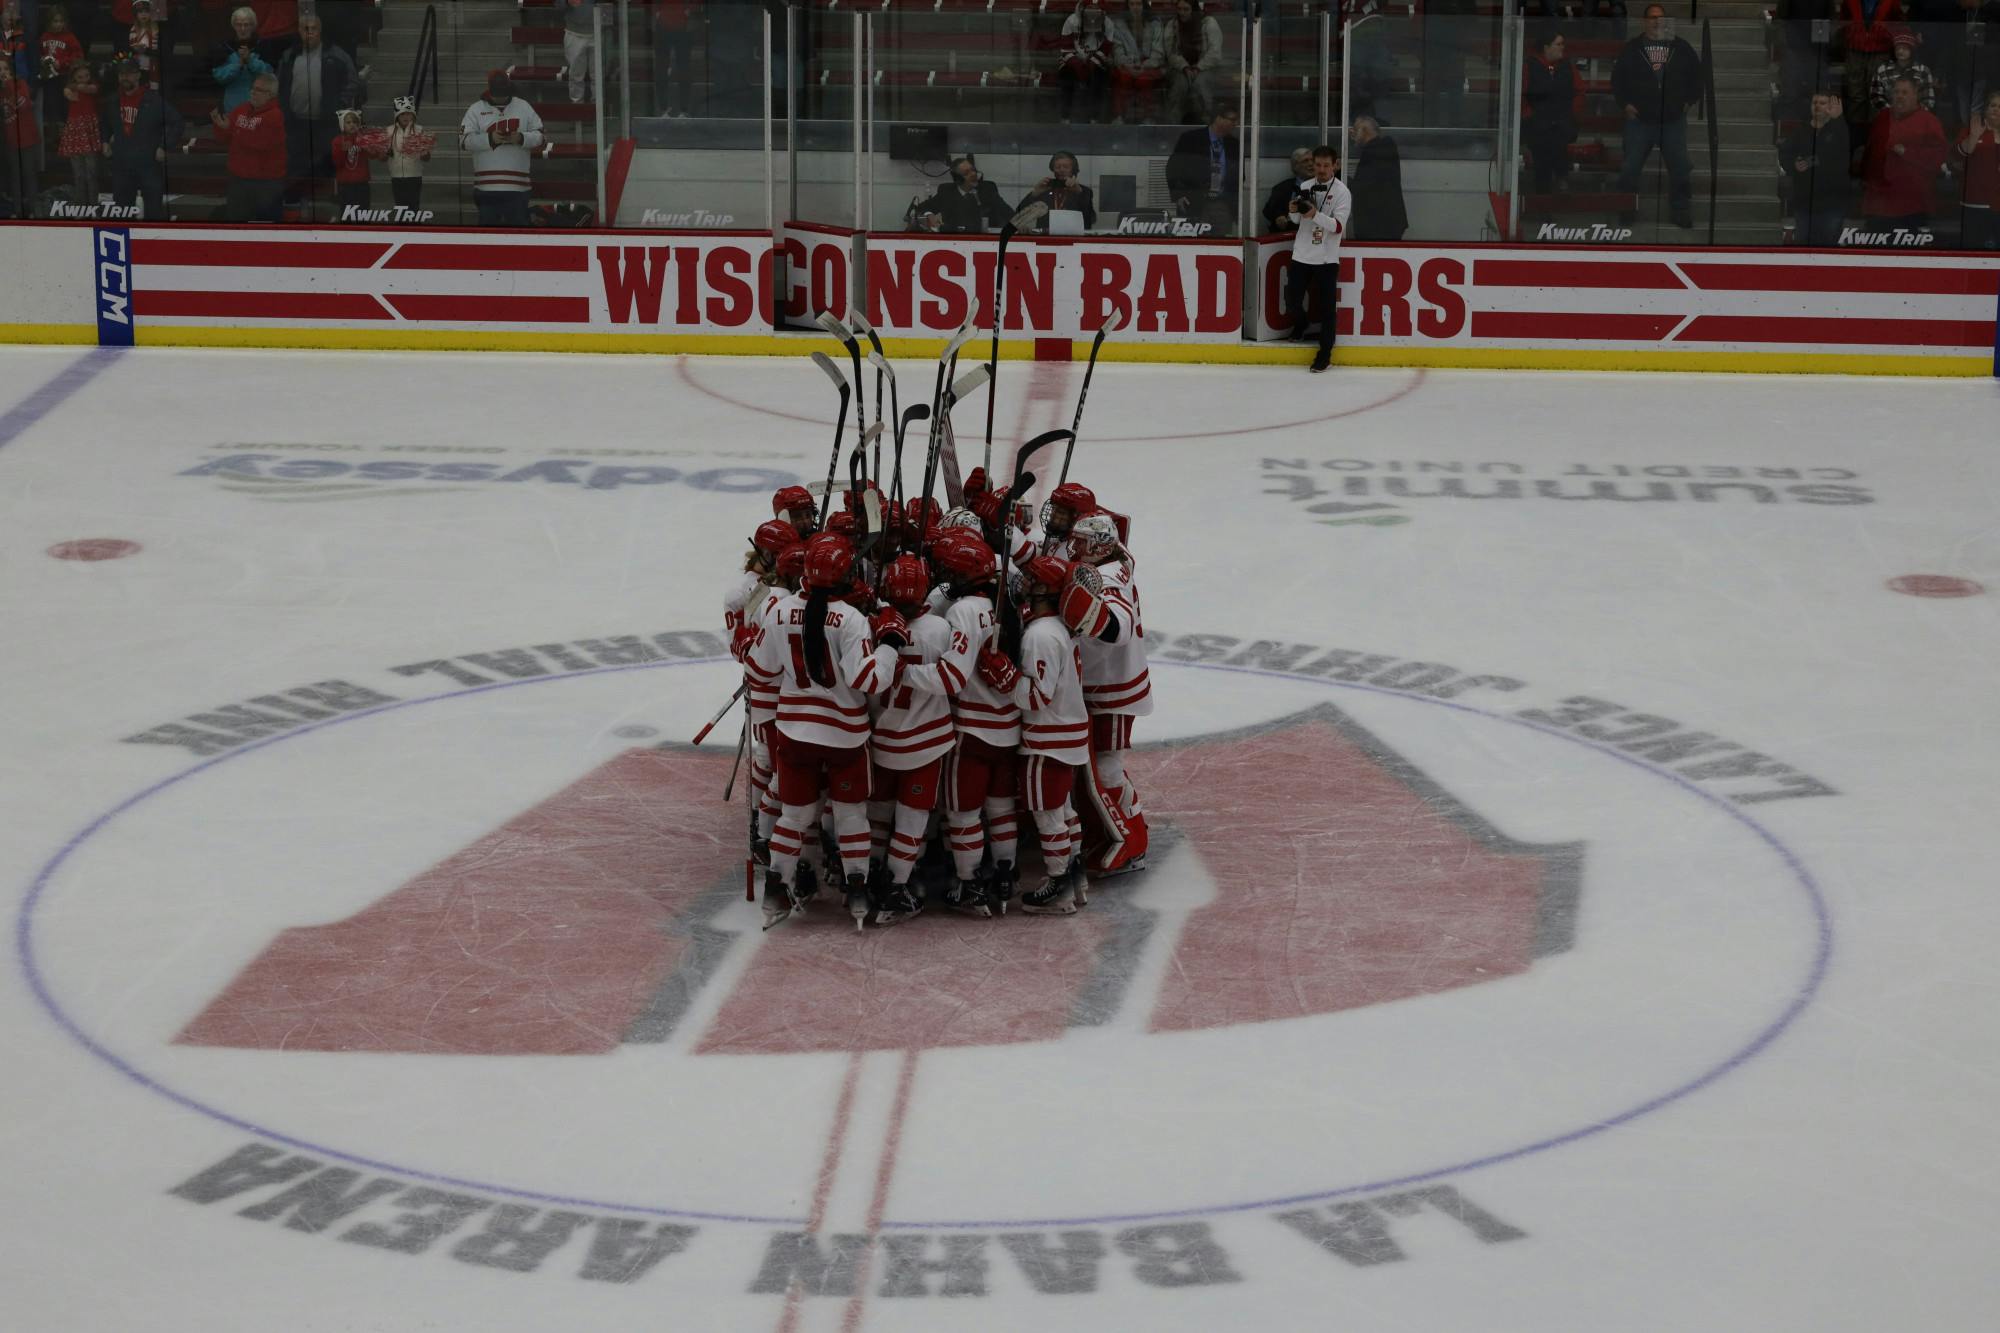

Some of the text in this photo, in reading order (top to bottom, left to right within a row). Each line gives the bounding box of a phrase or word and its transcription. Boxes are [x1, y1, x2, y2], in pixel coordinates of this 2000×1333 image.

[99, 230, 129, 326] CCM
[176, 453, 800, 493] Odyssey
[1259, 457, 1860, 481] CREDIT UNION
[1261, 474, 1876, 506] summit
[952, 631, 969, 655] 25
[120, 679, 399, 757] RINK
[1517, 695, 1841, 803] LANCE
[164, 1142, 700, 1285] ARENA
